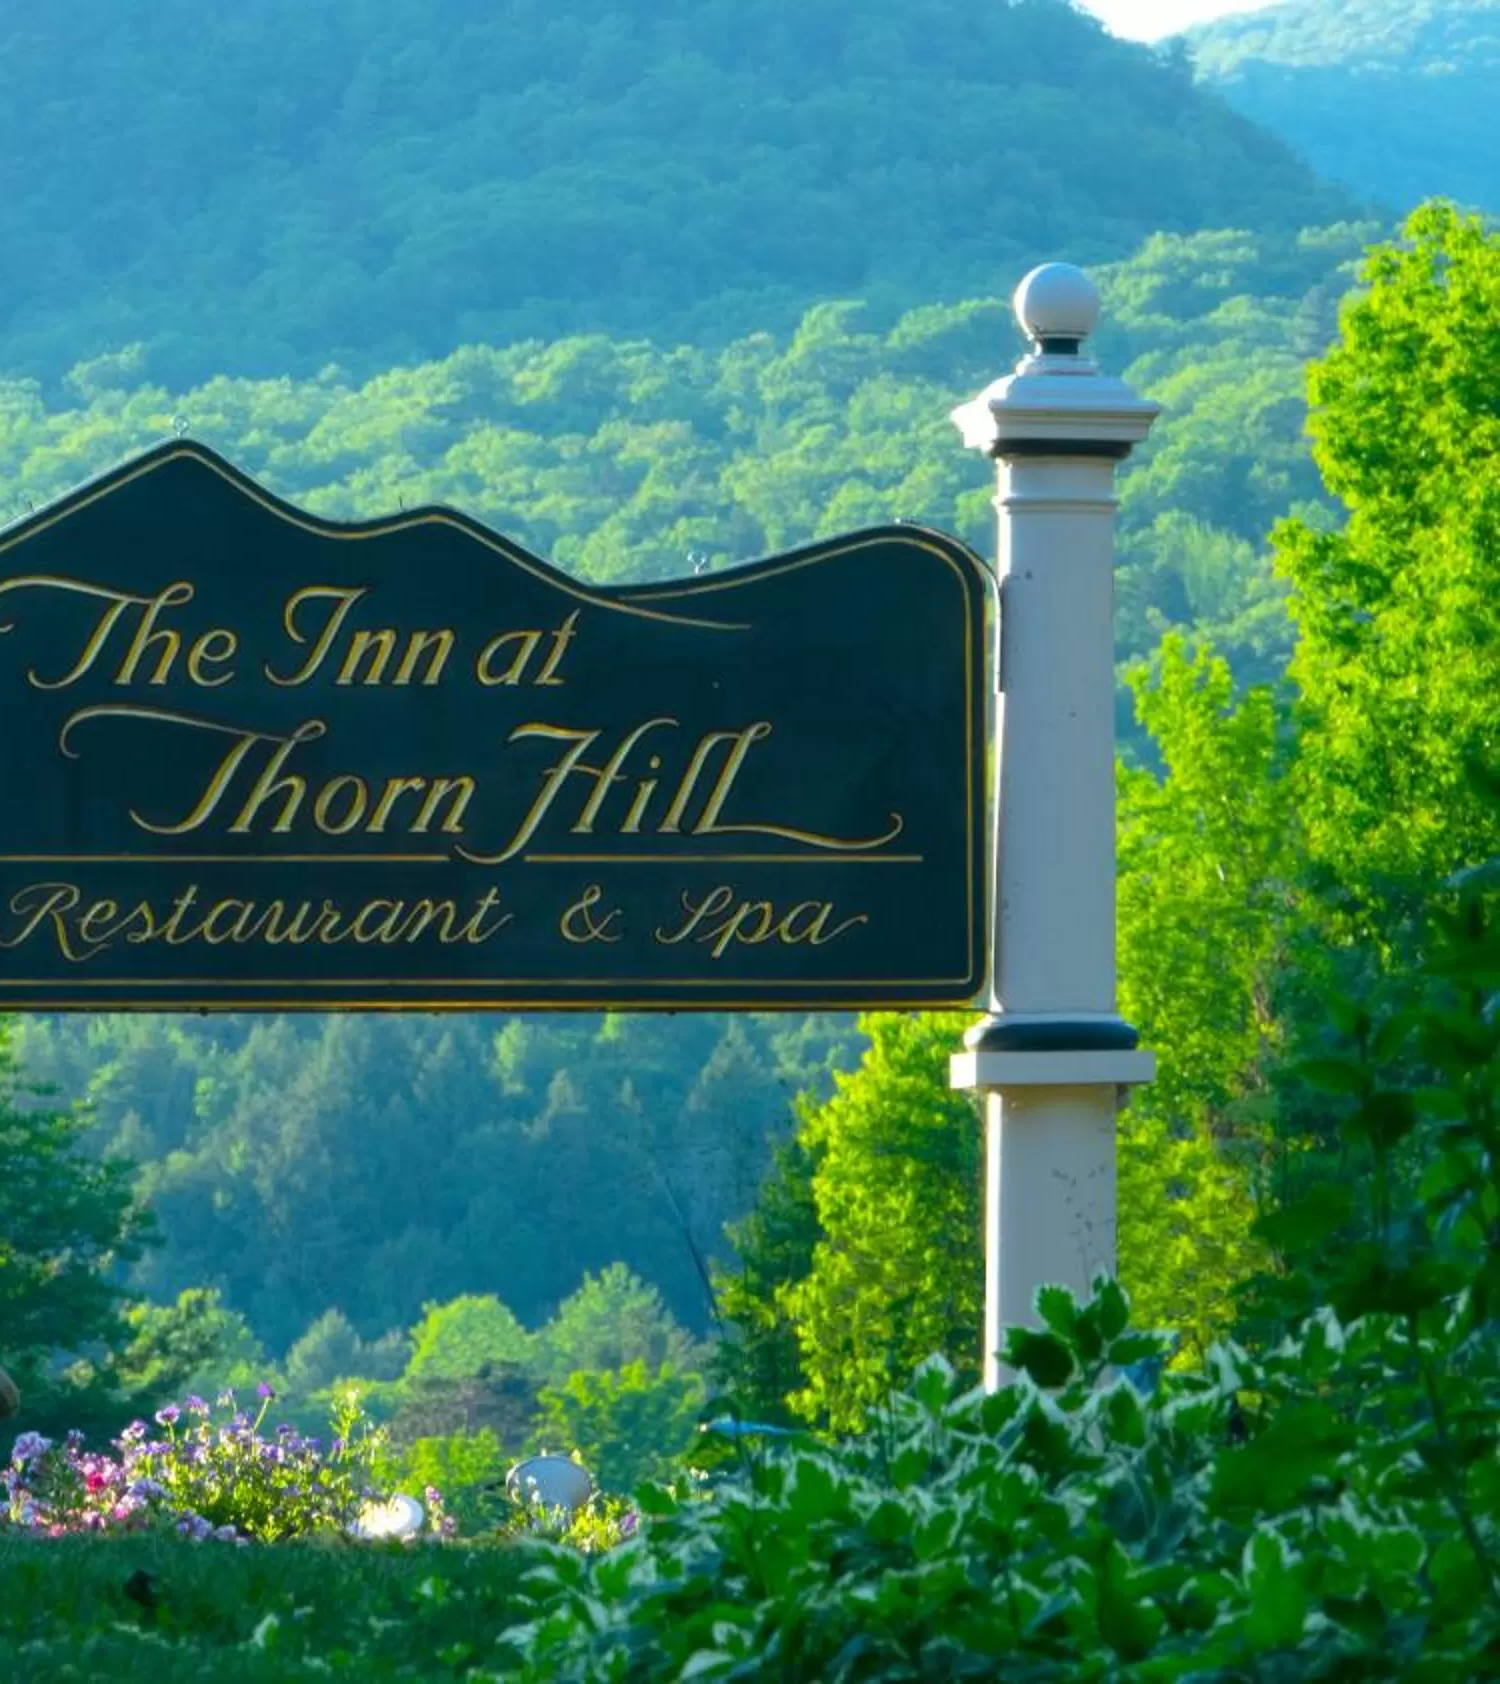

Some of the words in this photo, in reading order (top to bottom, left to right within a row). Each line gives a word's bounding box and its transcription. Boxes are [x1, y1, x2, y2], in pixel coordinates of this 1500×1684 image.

[264, 586, 454, 686] Inn
[476, 608, 580, 686] at
[60, 705, 475, 834] Thorn
[455, 718, 902, 864] Hill
[560, 886, 622, 942] &
[655, 886, 868, 958] Spa
